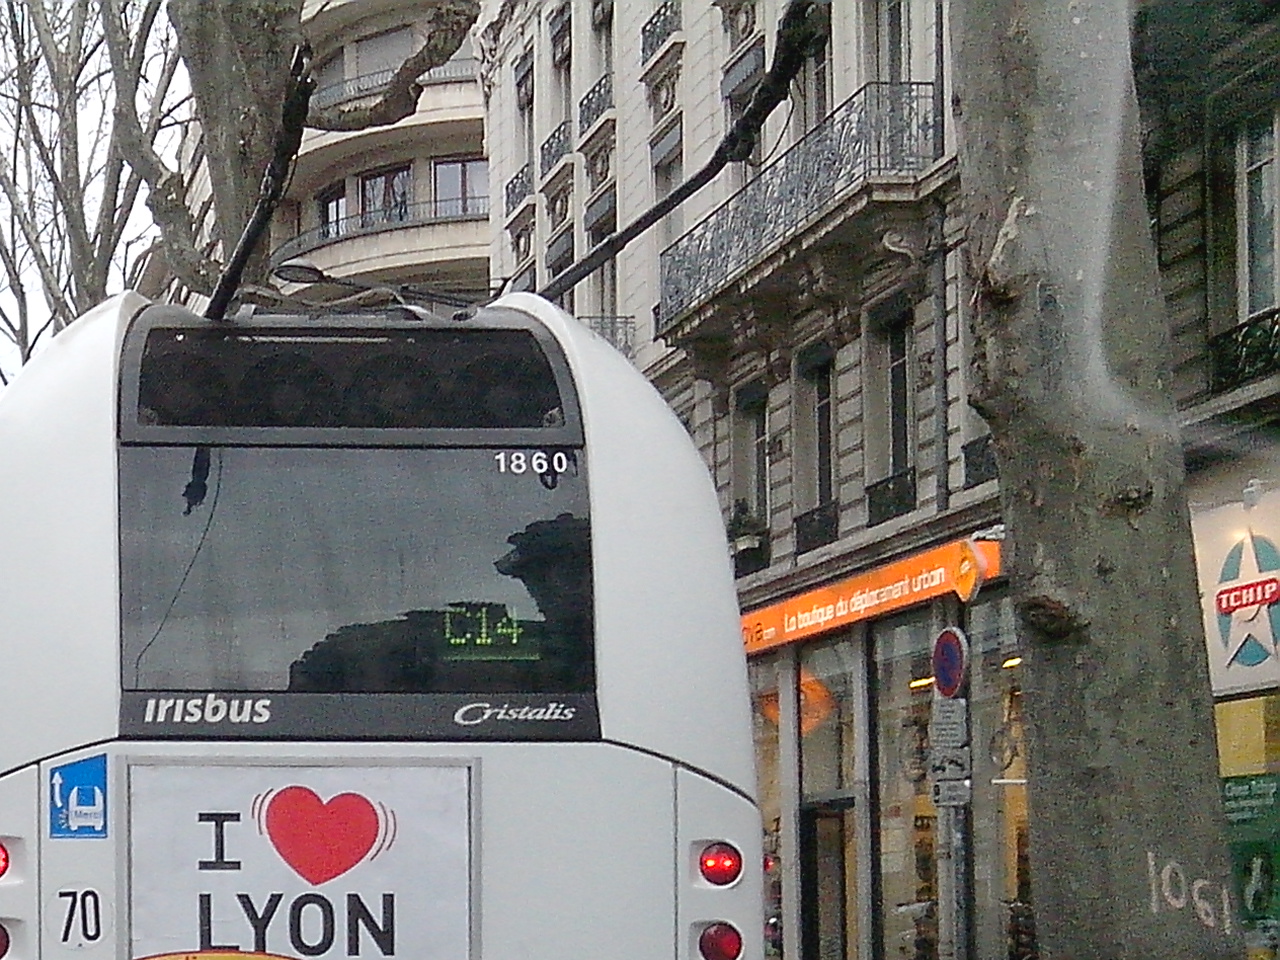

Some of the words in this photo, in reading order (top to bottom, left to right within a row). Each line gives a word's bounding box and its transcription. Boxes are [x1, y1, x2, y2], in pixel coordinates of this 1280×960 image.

[494, 451, 568, 473] 1860
[784, 613, 797, 633] La
[797, 604, 834, 627] boutique
[835, 596, 849, 617] du
[849, 574, 910, 613] déplacement
[911, 566, 945, 592] urbain
[1218, 582, 1277, 609] TCHIP
[445, 604, 523, 644] C14
[454, 702, 576, 726] Cristalis
[198, 812, 242, 870] I
[58, 889, 101, 943] 70
[199, 893, 395, 957] LYON
